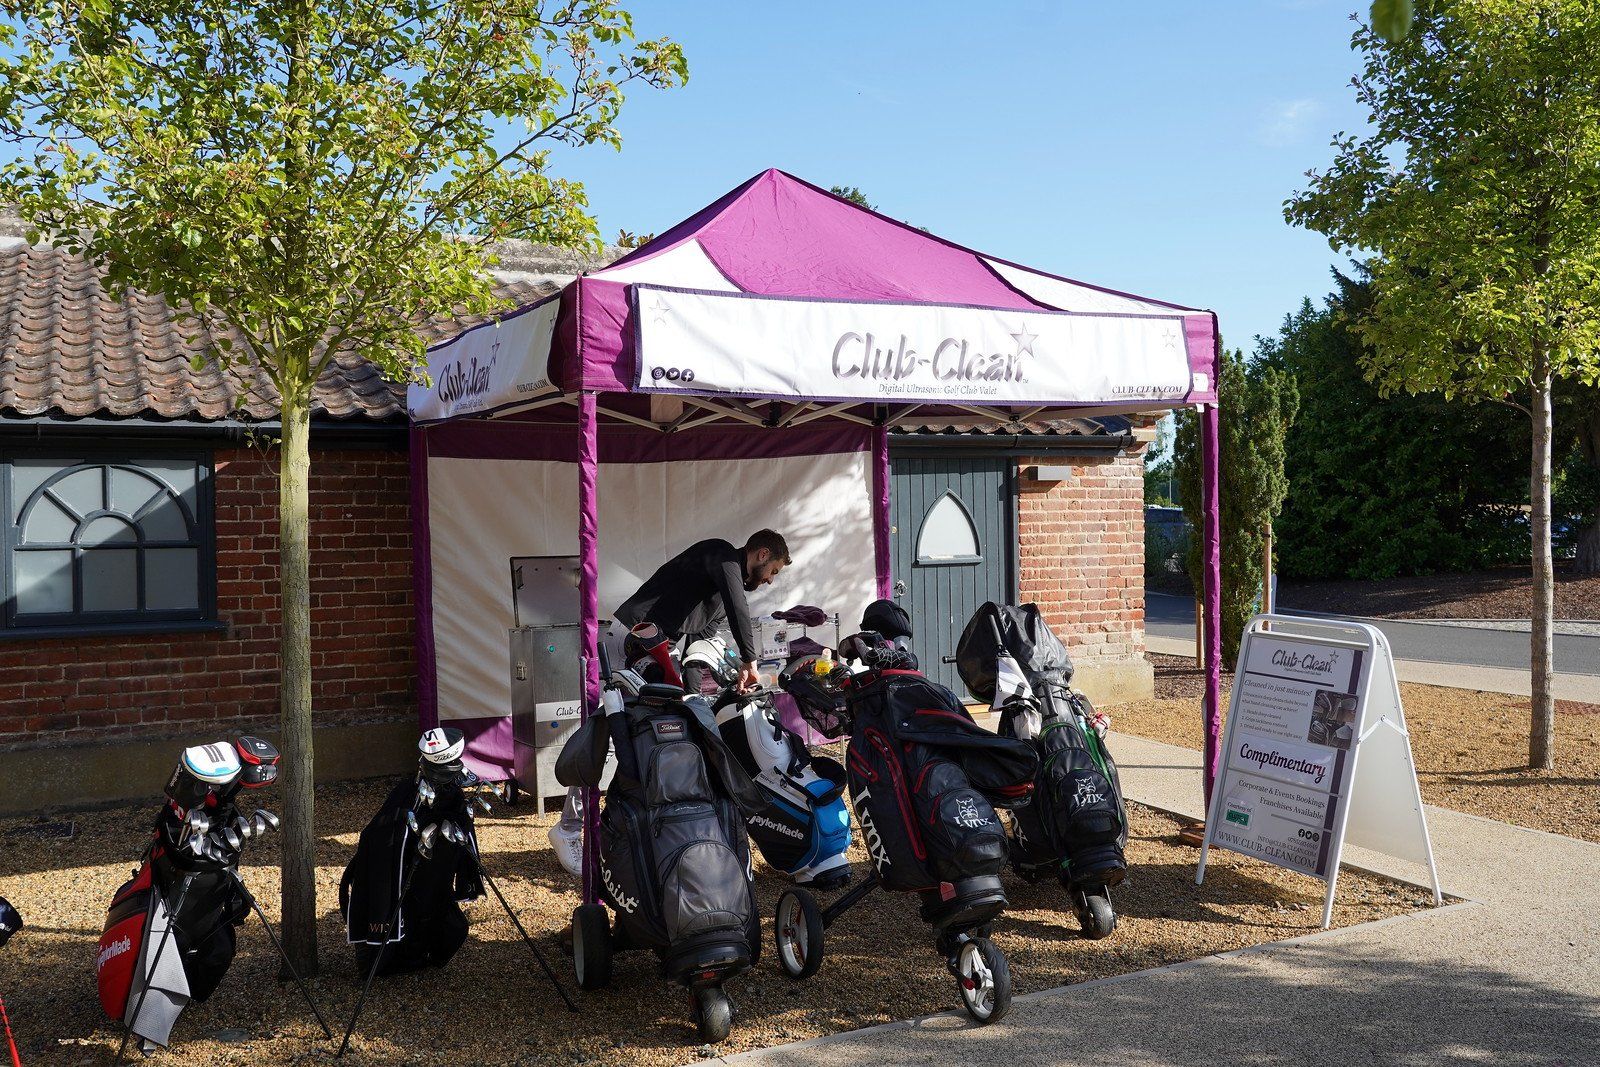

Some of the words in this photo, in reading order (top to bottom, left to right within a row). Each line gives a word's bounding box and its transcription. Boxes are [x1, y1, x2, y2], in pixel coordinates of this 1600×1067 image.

[832, 331, 1023, 383] Club-Clean
[878, 383, 905, 395] Digital
[943, 385, 960, 395] Golf
[960, 385, 978, 395] Club
[979, 385, 997, 395] Valet
[1272, 649, 1333, 672] Club-Clean
[1244, 679, 1267, 690] Cleaned
[1273, 685, 1286, 693] just
[556, 705, 582, 717] Club-C
[1240, 743, 1326, 784] Complimentary
[1238, 779, 1269, 794] Corporate
[1268, 787, 1274, 795] &
[1274, 788, 1295, 800] Events
[1296, 794, 1326, 809] Bookings
[1259, 797, 1293, 811] Franchises
[1292, 806, 1325, 820] Available
[746, 813, 804, 840] TaylorMade
[1218, 830, 1316, 868] WWW.CLUB-CLEAN.COM
[601, 862, 639, 914] leist
